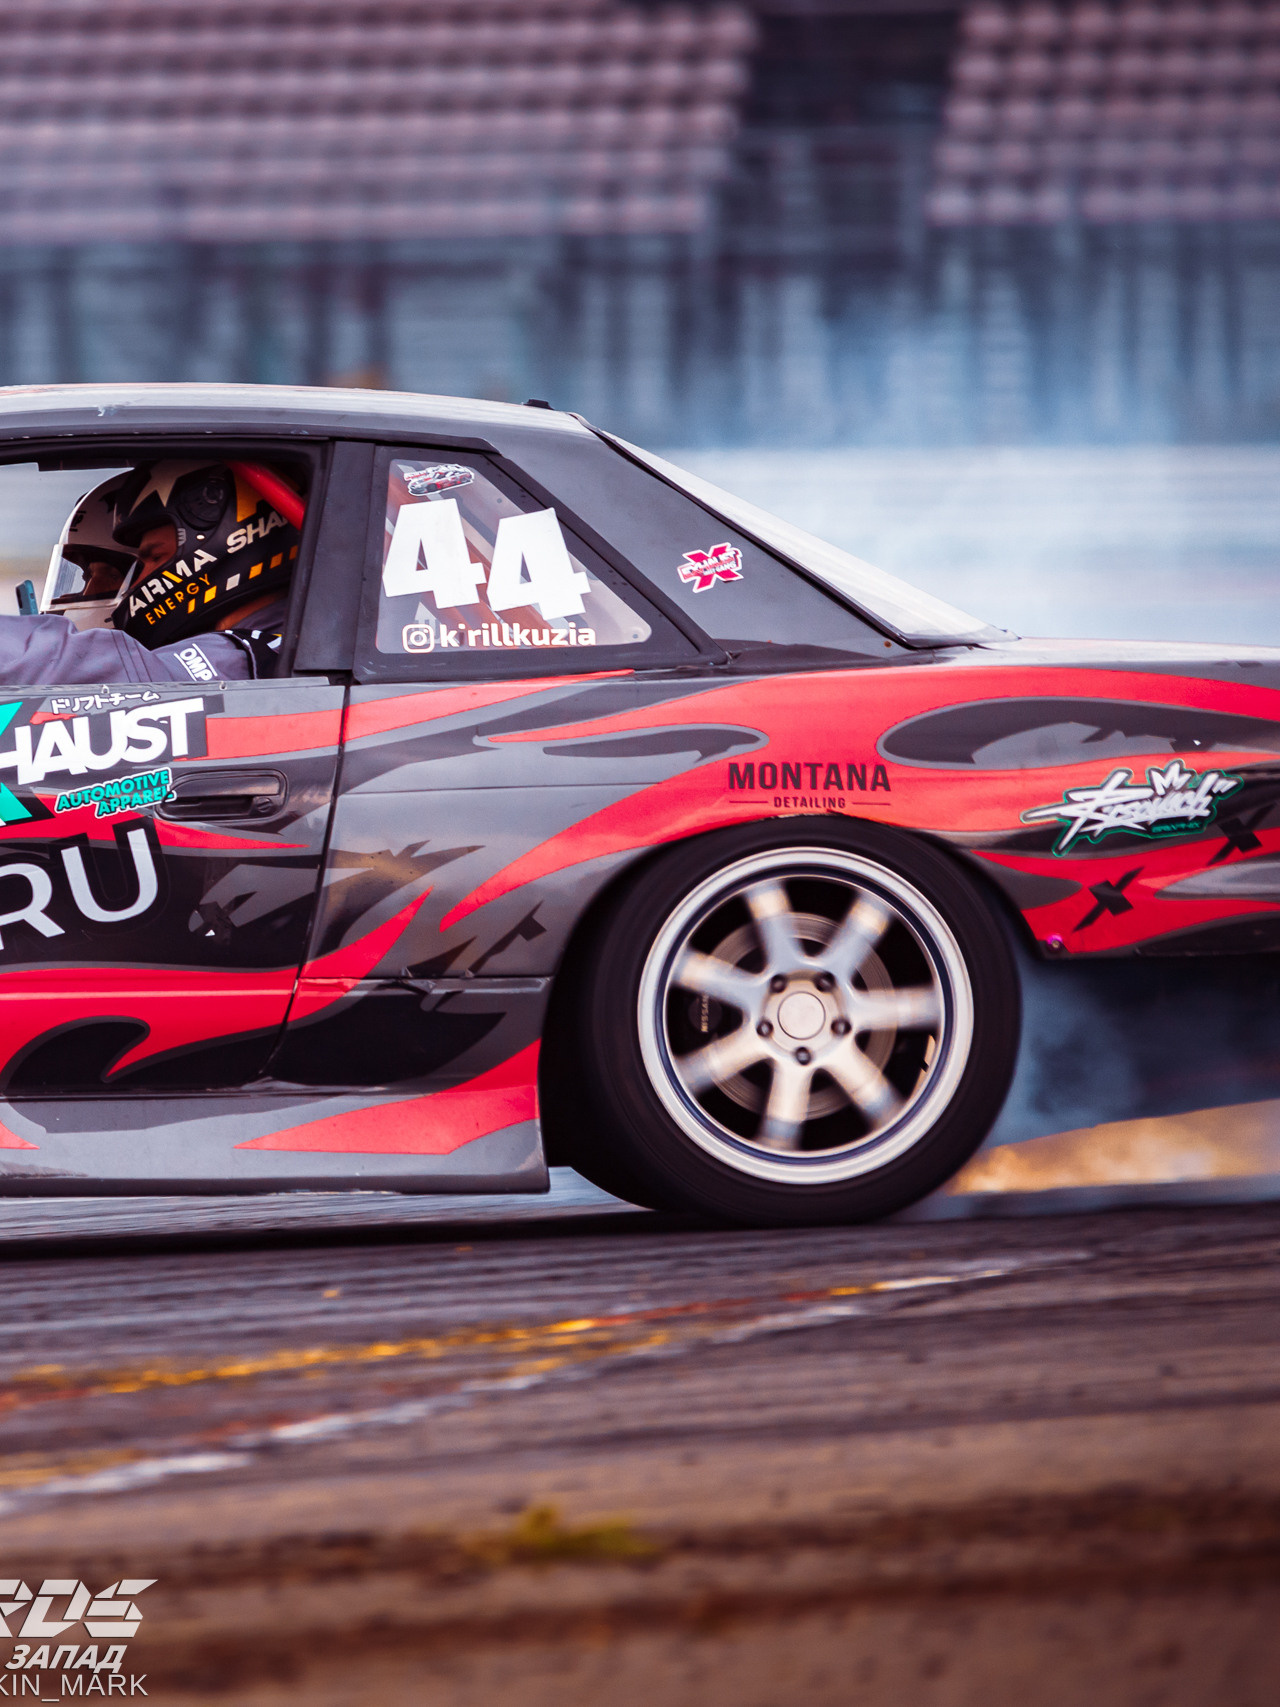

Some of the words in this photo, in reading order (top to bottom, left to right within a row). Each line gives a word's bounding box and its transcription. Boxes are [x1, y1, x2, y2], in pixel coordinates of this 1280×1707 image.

[226, 511, 289, 554] SHA
[382, 498, 591, 620] 44
[145, 573, 210, 625] ENERGY
[439, 622, 596, 648] krillkuzia
[179, 647, 213, 682] OMP
[51, 690, 160, 715] ドリフトチーム
[56, 769, 170, 812] AUTOMOTIVE
[728, 761, 892, 792] MONTANA
[773, 795, 847, 809] DETAILING
